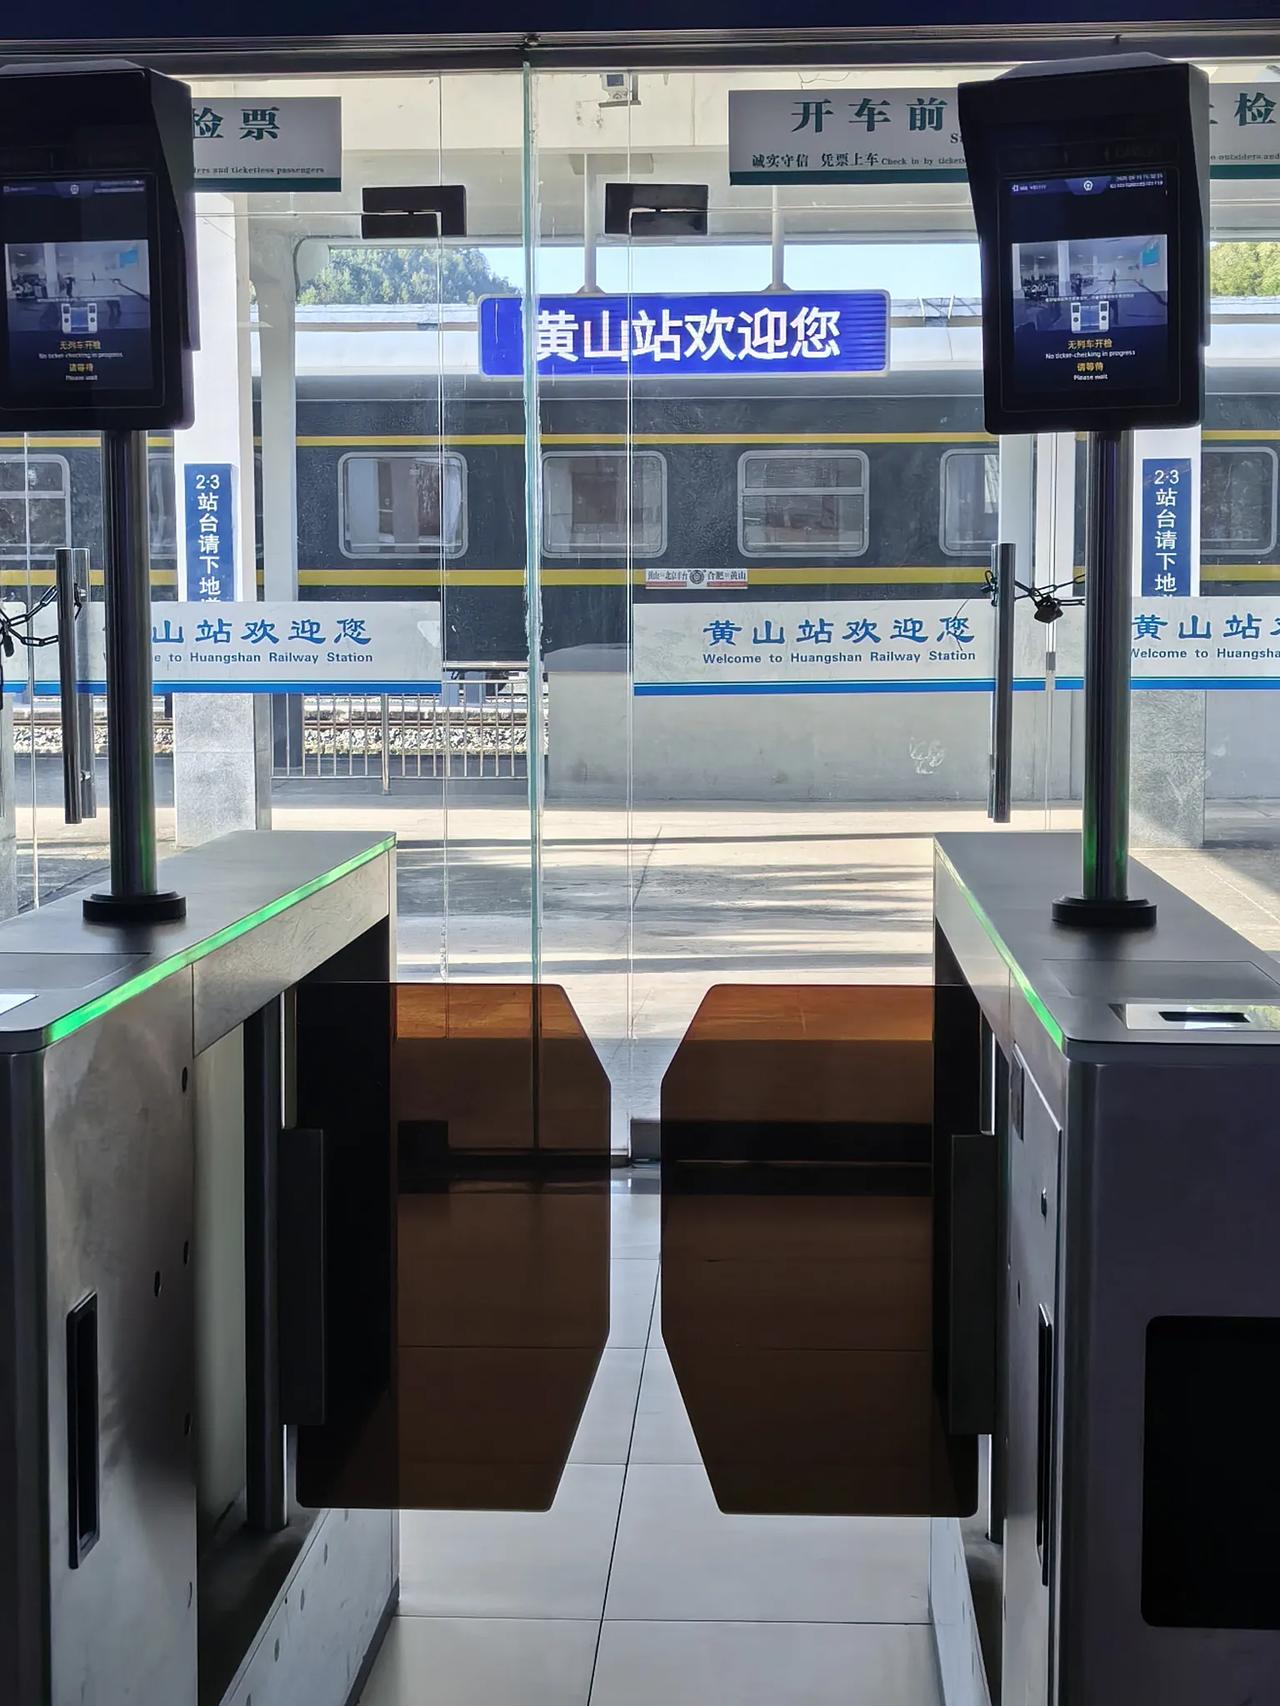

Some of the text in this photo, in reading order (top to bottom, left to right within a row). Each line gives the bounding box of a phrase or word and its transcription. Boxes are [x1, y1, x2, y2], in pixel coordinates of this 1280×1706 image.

[192, 106, 281, 141] 检票
[791, 97, 949, 134] 开车前
[212, 166, 229, 174] and
[276, 167, 325, 175] passengers
[820, 152, 879, 168] 凭票上车
[881, 157, 907, 165] Check
[911, 157, 920, 165] in
[923, 157, 933, 166] by
[536, 306, 842, 363] 黄山站欢迎您
[197, 492, 221, 602] 站台请下地
[1154, 487, 1179, 597] 站台请下地
[702, 616, 976, 647] 黄山站欢迎您
[168, 653, 182, 663] to
[190, 652, 261, 665] Huangshan
[269, 651, 319, 664] Railway
[326, 652, 373, 663] Station
[703, 650, 976, 664] Welcome to Huangshan Railway Station
[1131, 648, 1280, 661] Welcome to Huangsha
